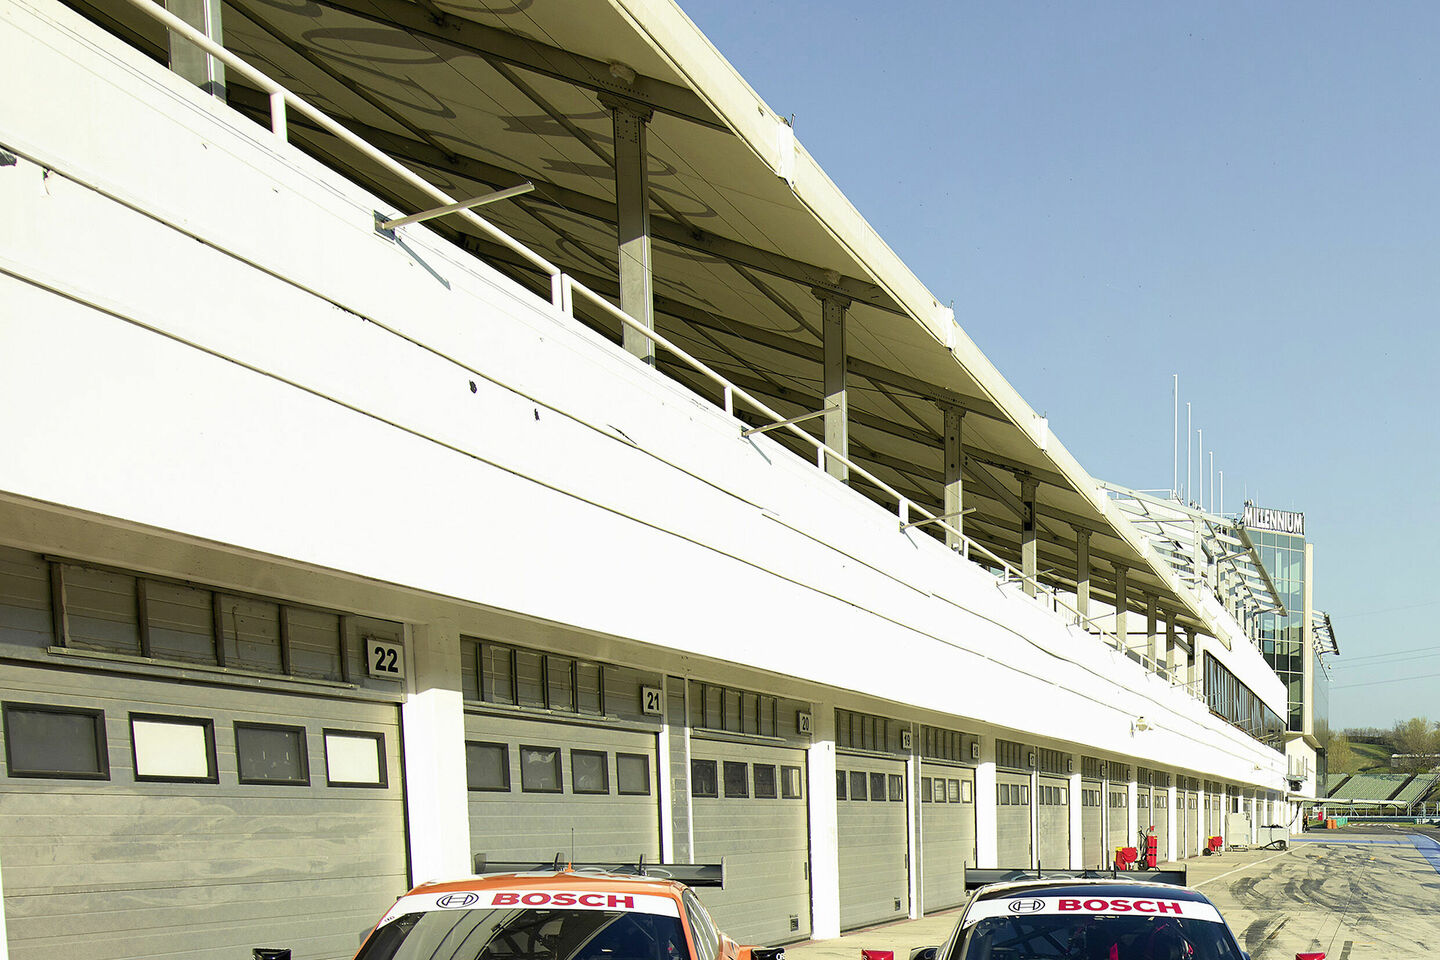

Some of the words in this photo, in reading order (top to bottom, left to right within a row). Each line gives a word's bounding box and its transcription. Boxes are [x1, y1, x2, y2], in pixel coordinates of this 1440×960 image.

[1243, 506, 1303, 533] MILLENNIUM
[374, 646, 399, 673] 22
[647, 691, 660, 711] 21
[801, 716, 810, 731] 20
[491, 892, 635, 909] BOSCH
[1058, 899, 1183, 915] BOSCH
